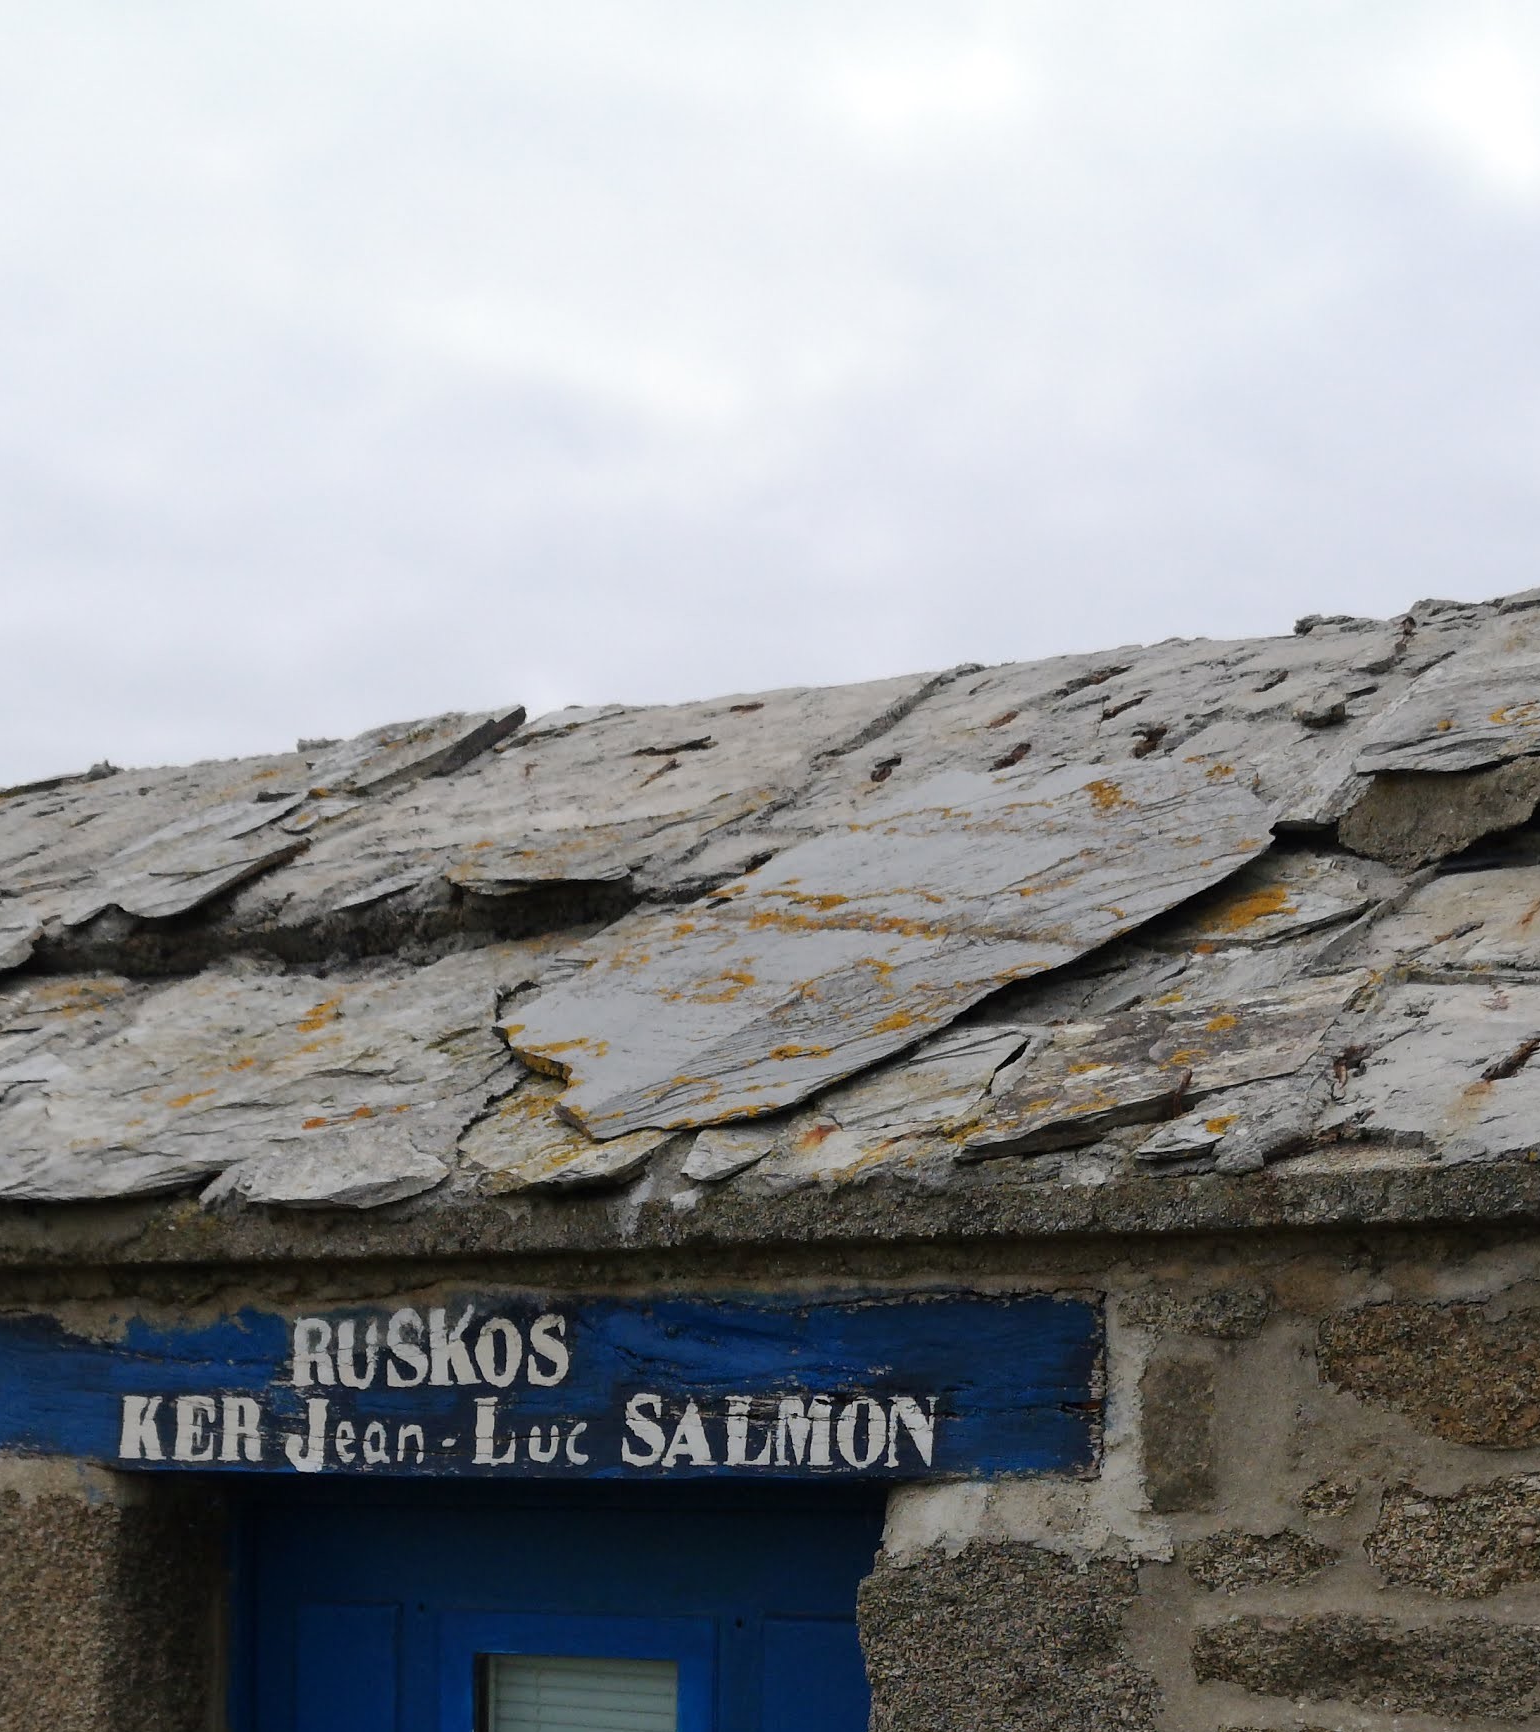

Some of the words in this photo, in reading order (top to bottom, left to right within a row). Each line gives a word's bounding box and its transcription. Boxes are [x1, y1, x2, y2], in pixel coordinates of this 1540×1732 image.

[291, 1308, 569, 1389] RUSKOS
[118, 1395, 263, 1462] KER
[622, 1392, 939, 1468] SALMON
